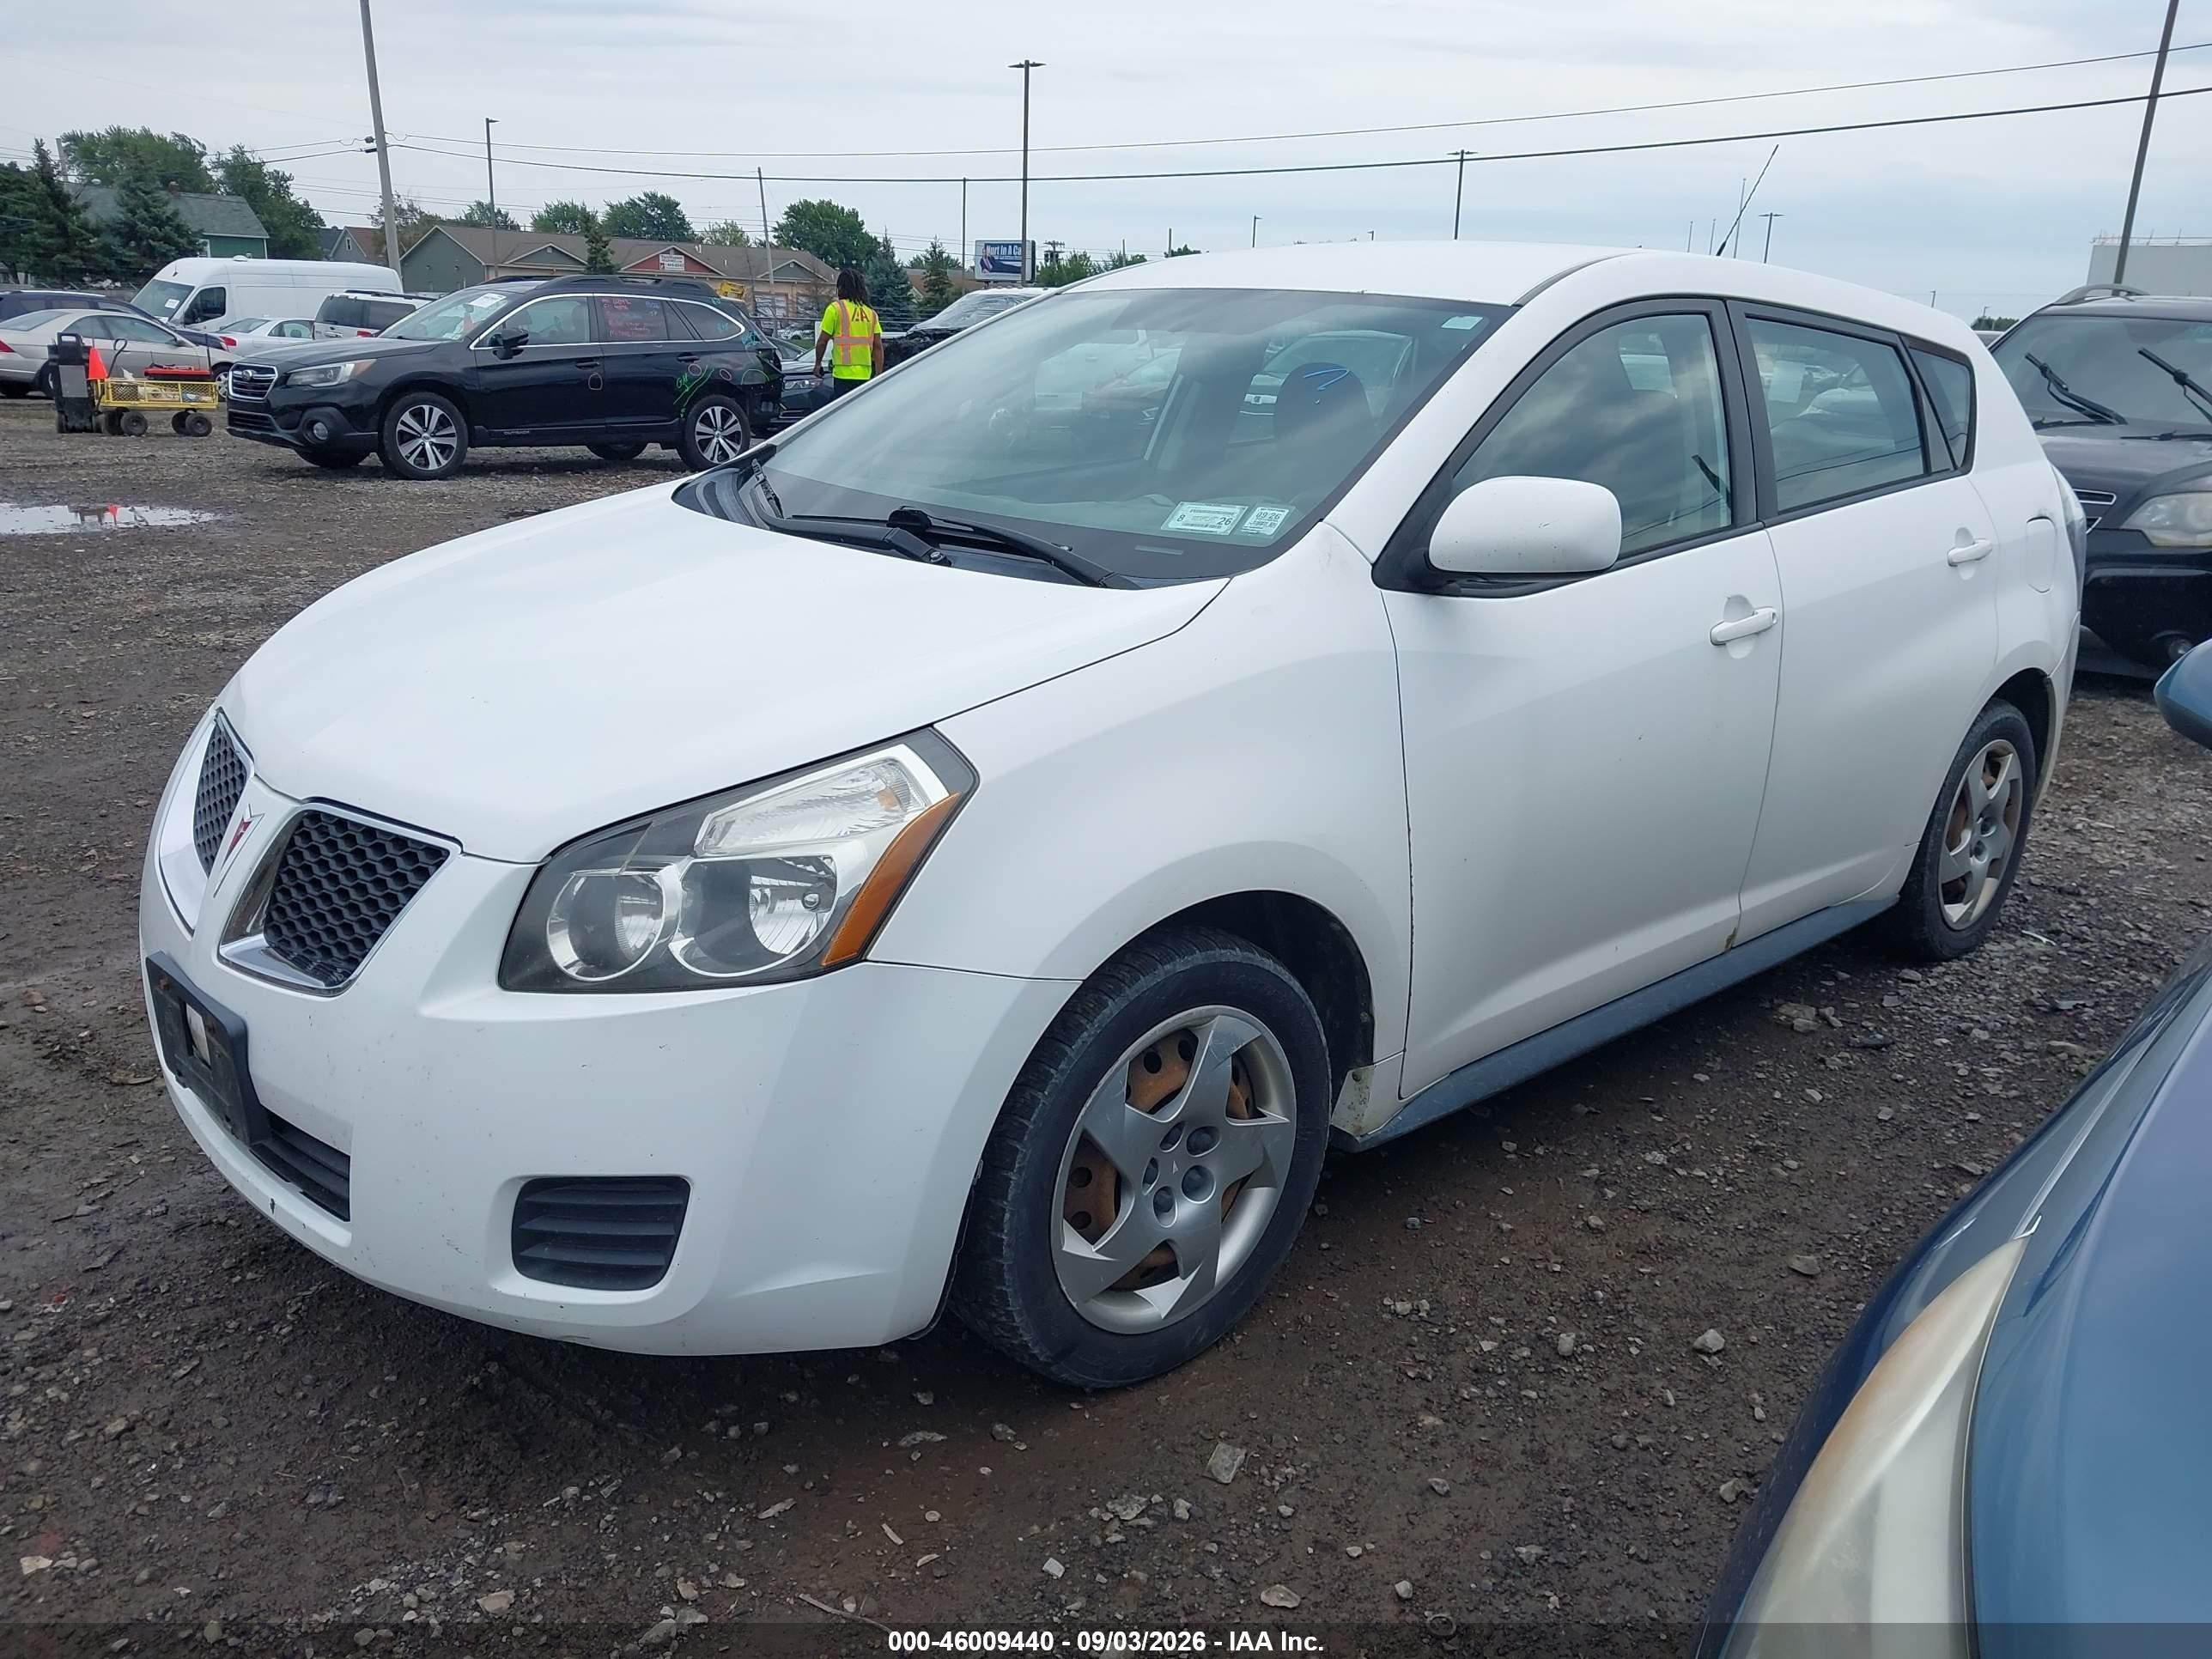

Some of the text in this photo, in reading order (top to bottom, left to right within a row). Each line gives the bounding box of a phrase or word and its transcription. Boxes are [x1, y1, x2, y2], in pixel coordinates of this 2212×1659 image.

[1000, 245, 1007, 255] In
[1007, 245, 1012, 255] A
[1176, 514, 1186, 522] 8
[1217, 517, 1234, 526] 26
